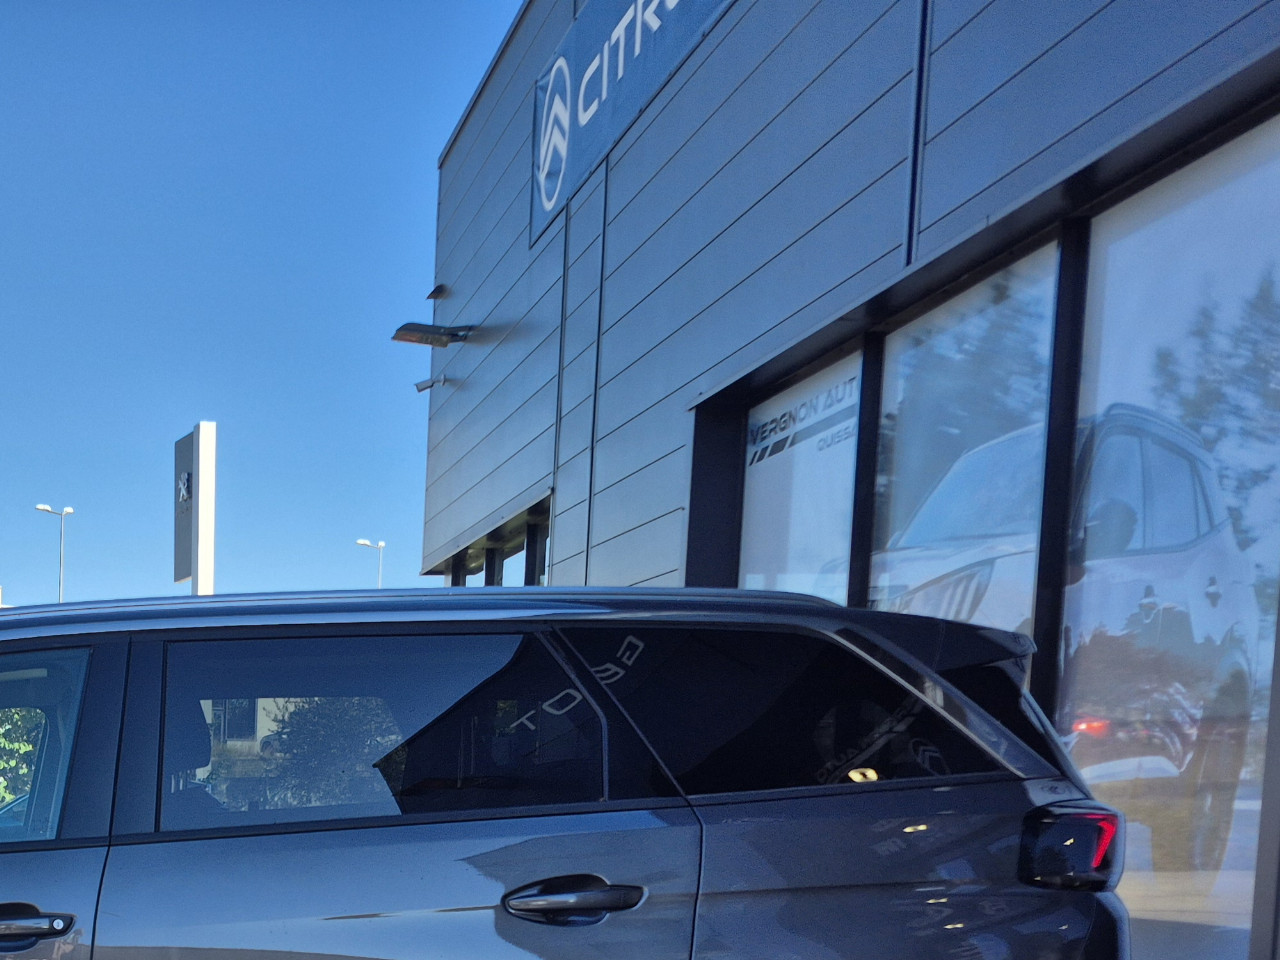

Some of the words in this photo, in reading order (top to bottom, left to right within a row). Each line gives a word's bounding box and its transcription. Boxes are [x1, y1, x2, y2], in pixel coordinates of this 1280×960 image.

[578, 0, 679, 127] CITR
[750, 395, 819, 446] VERGNON
[823, 375, 858, 411] AUT
